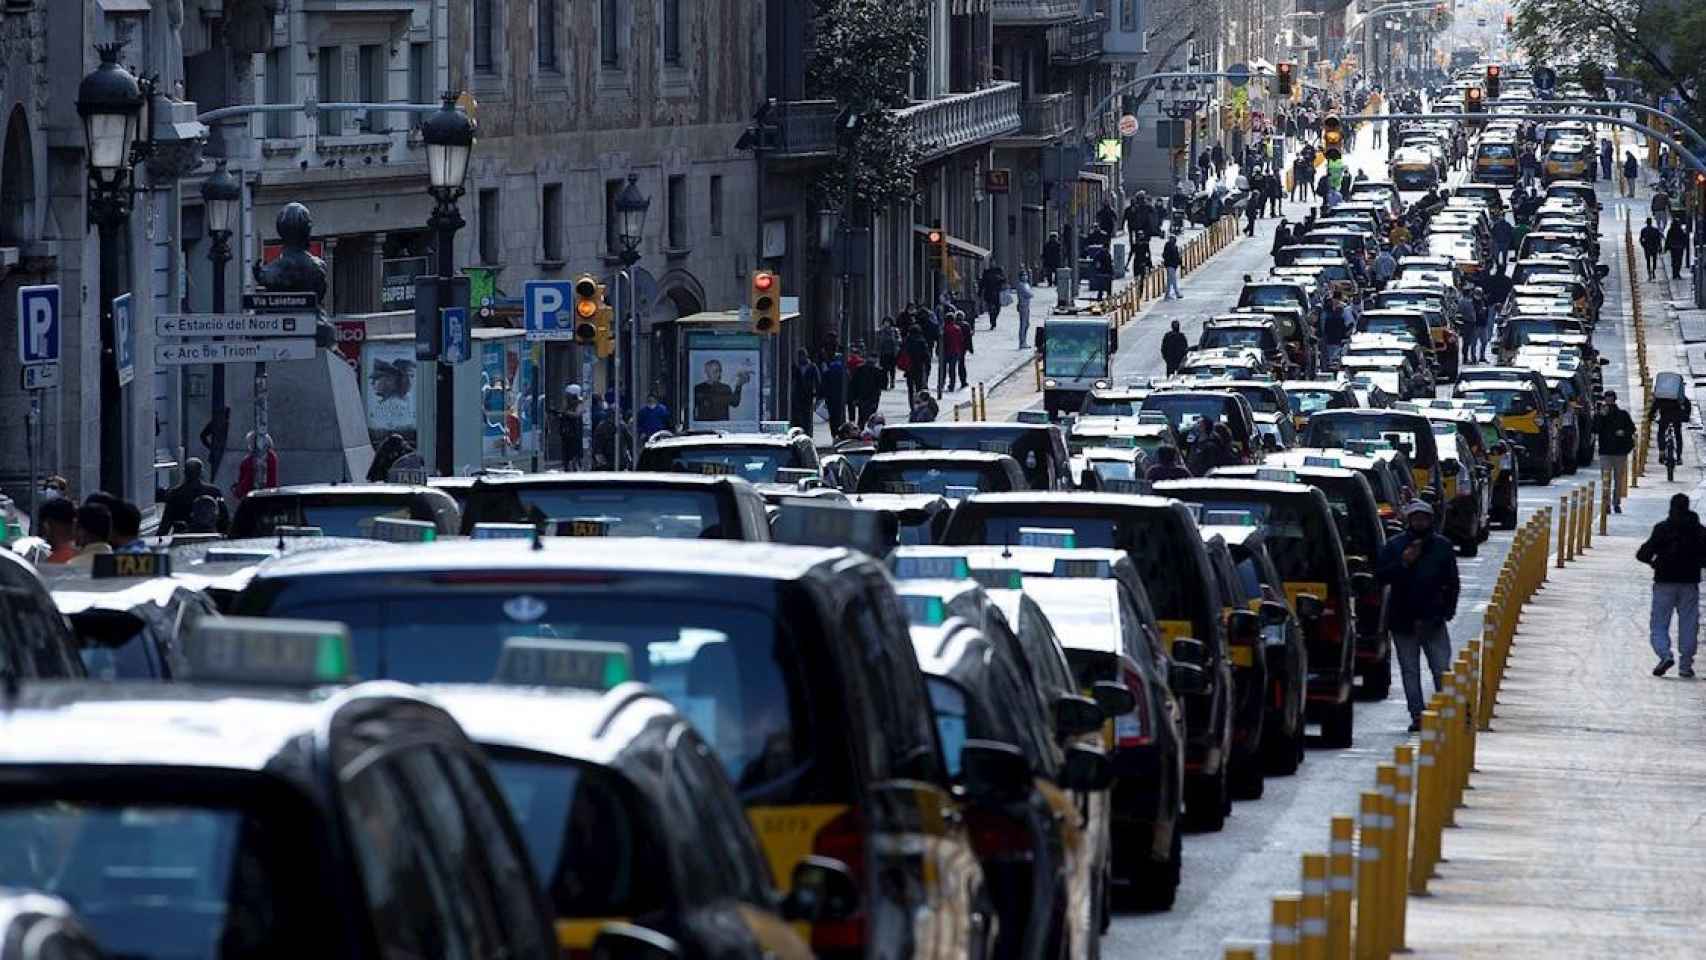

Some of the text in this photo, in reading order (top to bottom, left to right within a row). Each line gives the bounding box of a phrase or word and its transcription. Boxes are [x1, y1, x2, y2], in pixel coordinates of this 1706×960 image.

[534, 287, 562, 330] P
[28, 296, 52, 354] P
[178, 317, 278, 331] Estació del Nord
[178, 346, 199, 359] Arc
[116, 555, 154, 577] TAXI
